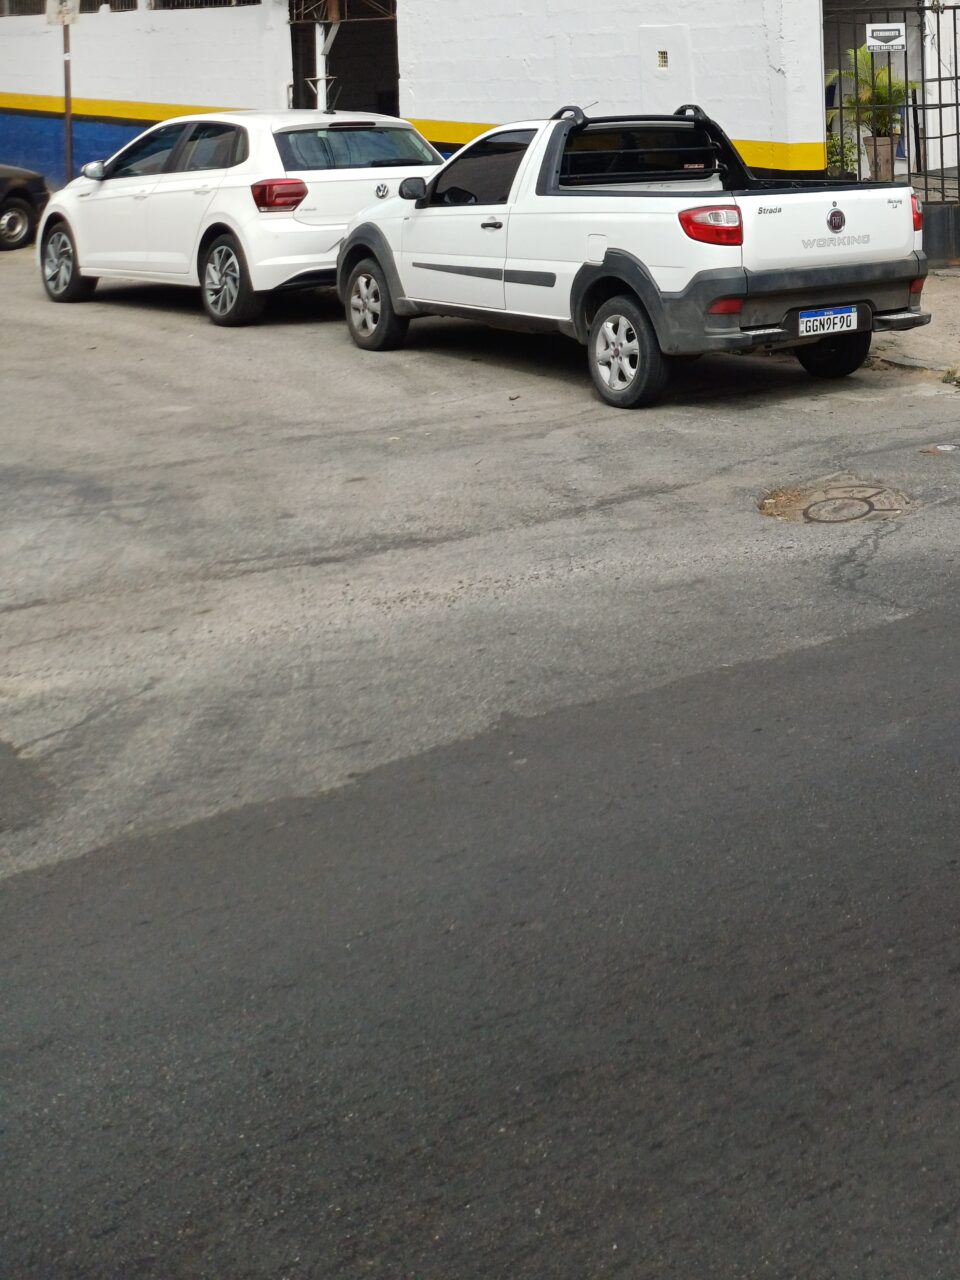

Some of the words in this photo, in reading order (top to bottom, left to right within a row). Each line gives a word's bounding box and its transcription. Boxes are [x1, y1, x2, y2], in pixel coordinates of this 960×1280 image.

[758, 206, 782, 215] Strada
[802, 234, 871, 249] WORKING
[805, 315, 852, 333] GGN9F90
